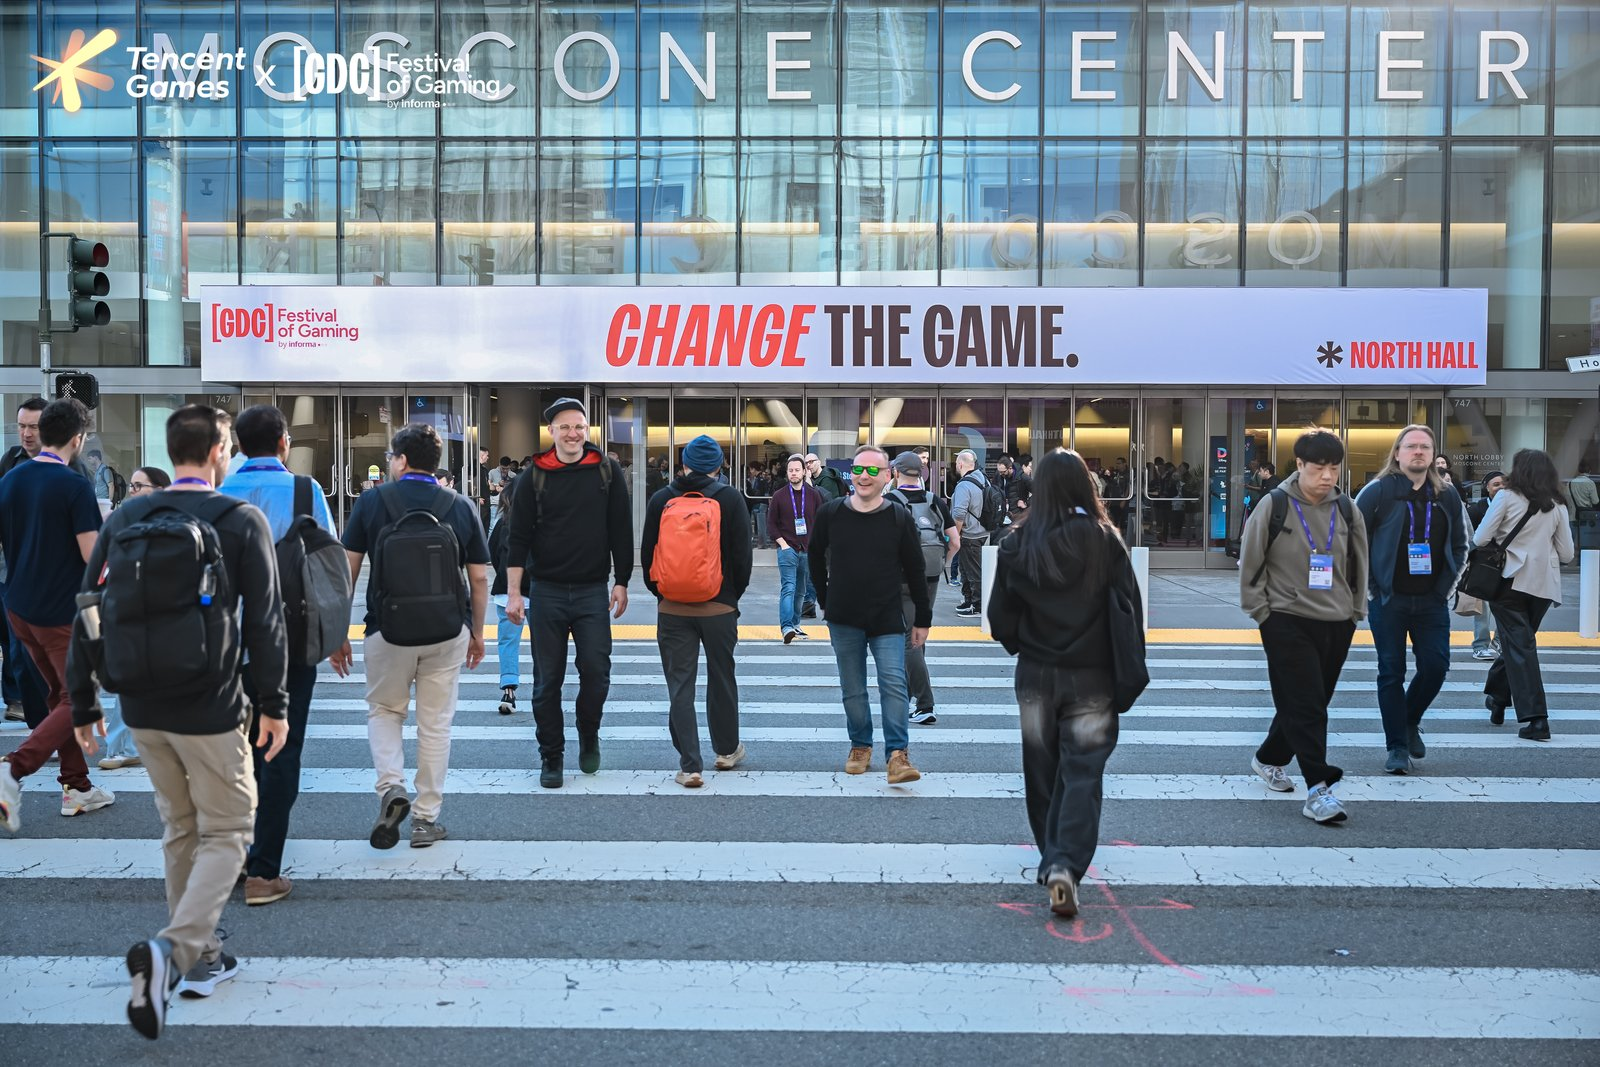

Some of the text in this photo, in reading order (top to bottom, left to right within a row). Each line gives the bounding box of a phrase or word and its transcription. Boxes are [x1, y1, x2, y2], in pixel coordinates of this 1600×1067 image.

[153, 30, 1530, 101] MOSCONE CENTER
[278, 308, 337, 322] Festival
[278, 324, 359, 341] of Gaming
[605, 303, 1078, 367] CHANGE THE GAME.
[278, 341, 287, 349] by
[1350, 341, 1479, 368] NORTH HALL
[215, 395, 232, 404] 747
[1454, 399, 1471, 407] 747
